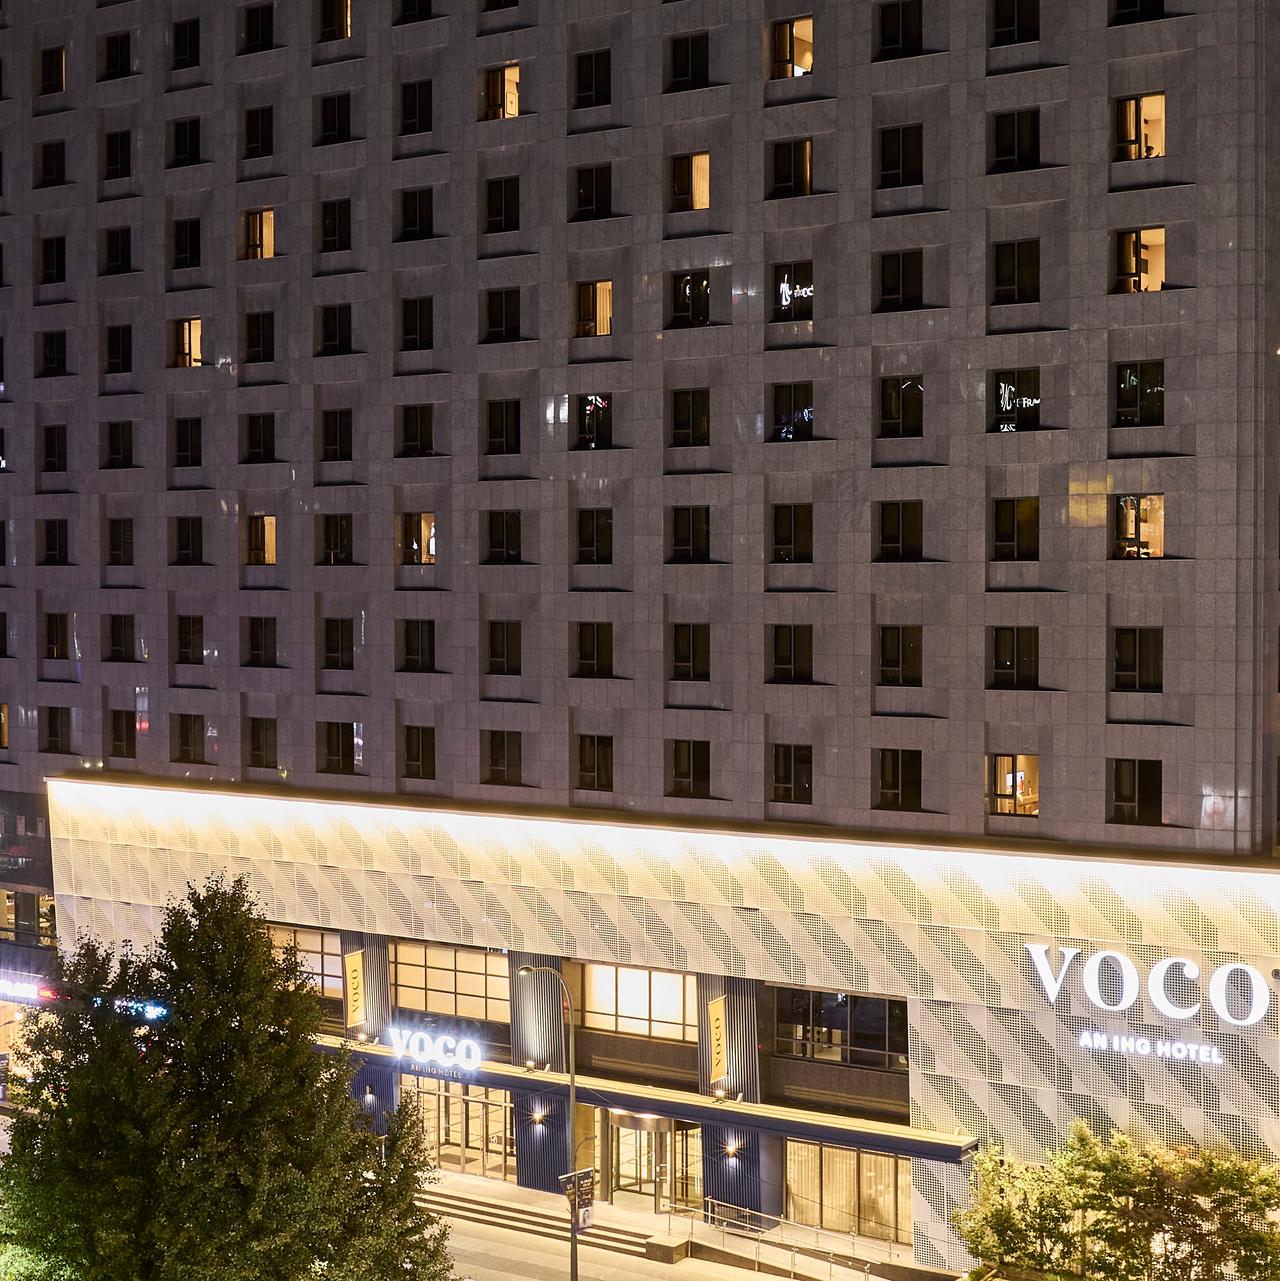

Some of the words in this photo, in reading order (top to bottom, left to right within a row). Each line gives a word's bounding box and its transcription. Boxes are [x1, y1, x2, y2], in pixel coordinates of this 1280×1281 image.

[1079, 1031, 1107, 1050] AN
[1113, 1035, 1151, 1056] IHG
[1156, 1041, 1224, 1064] HOTEL
[439, 1068, 462, 1079] HOTEL
